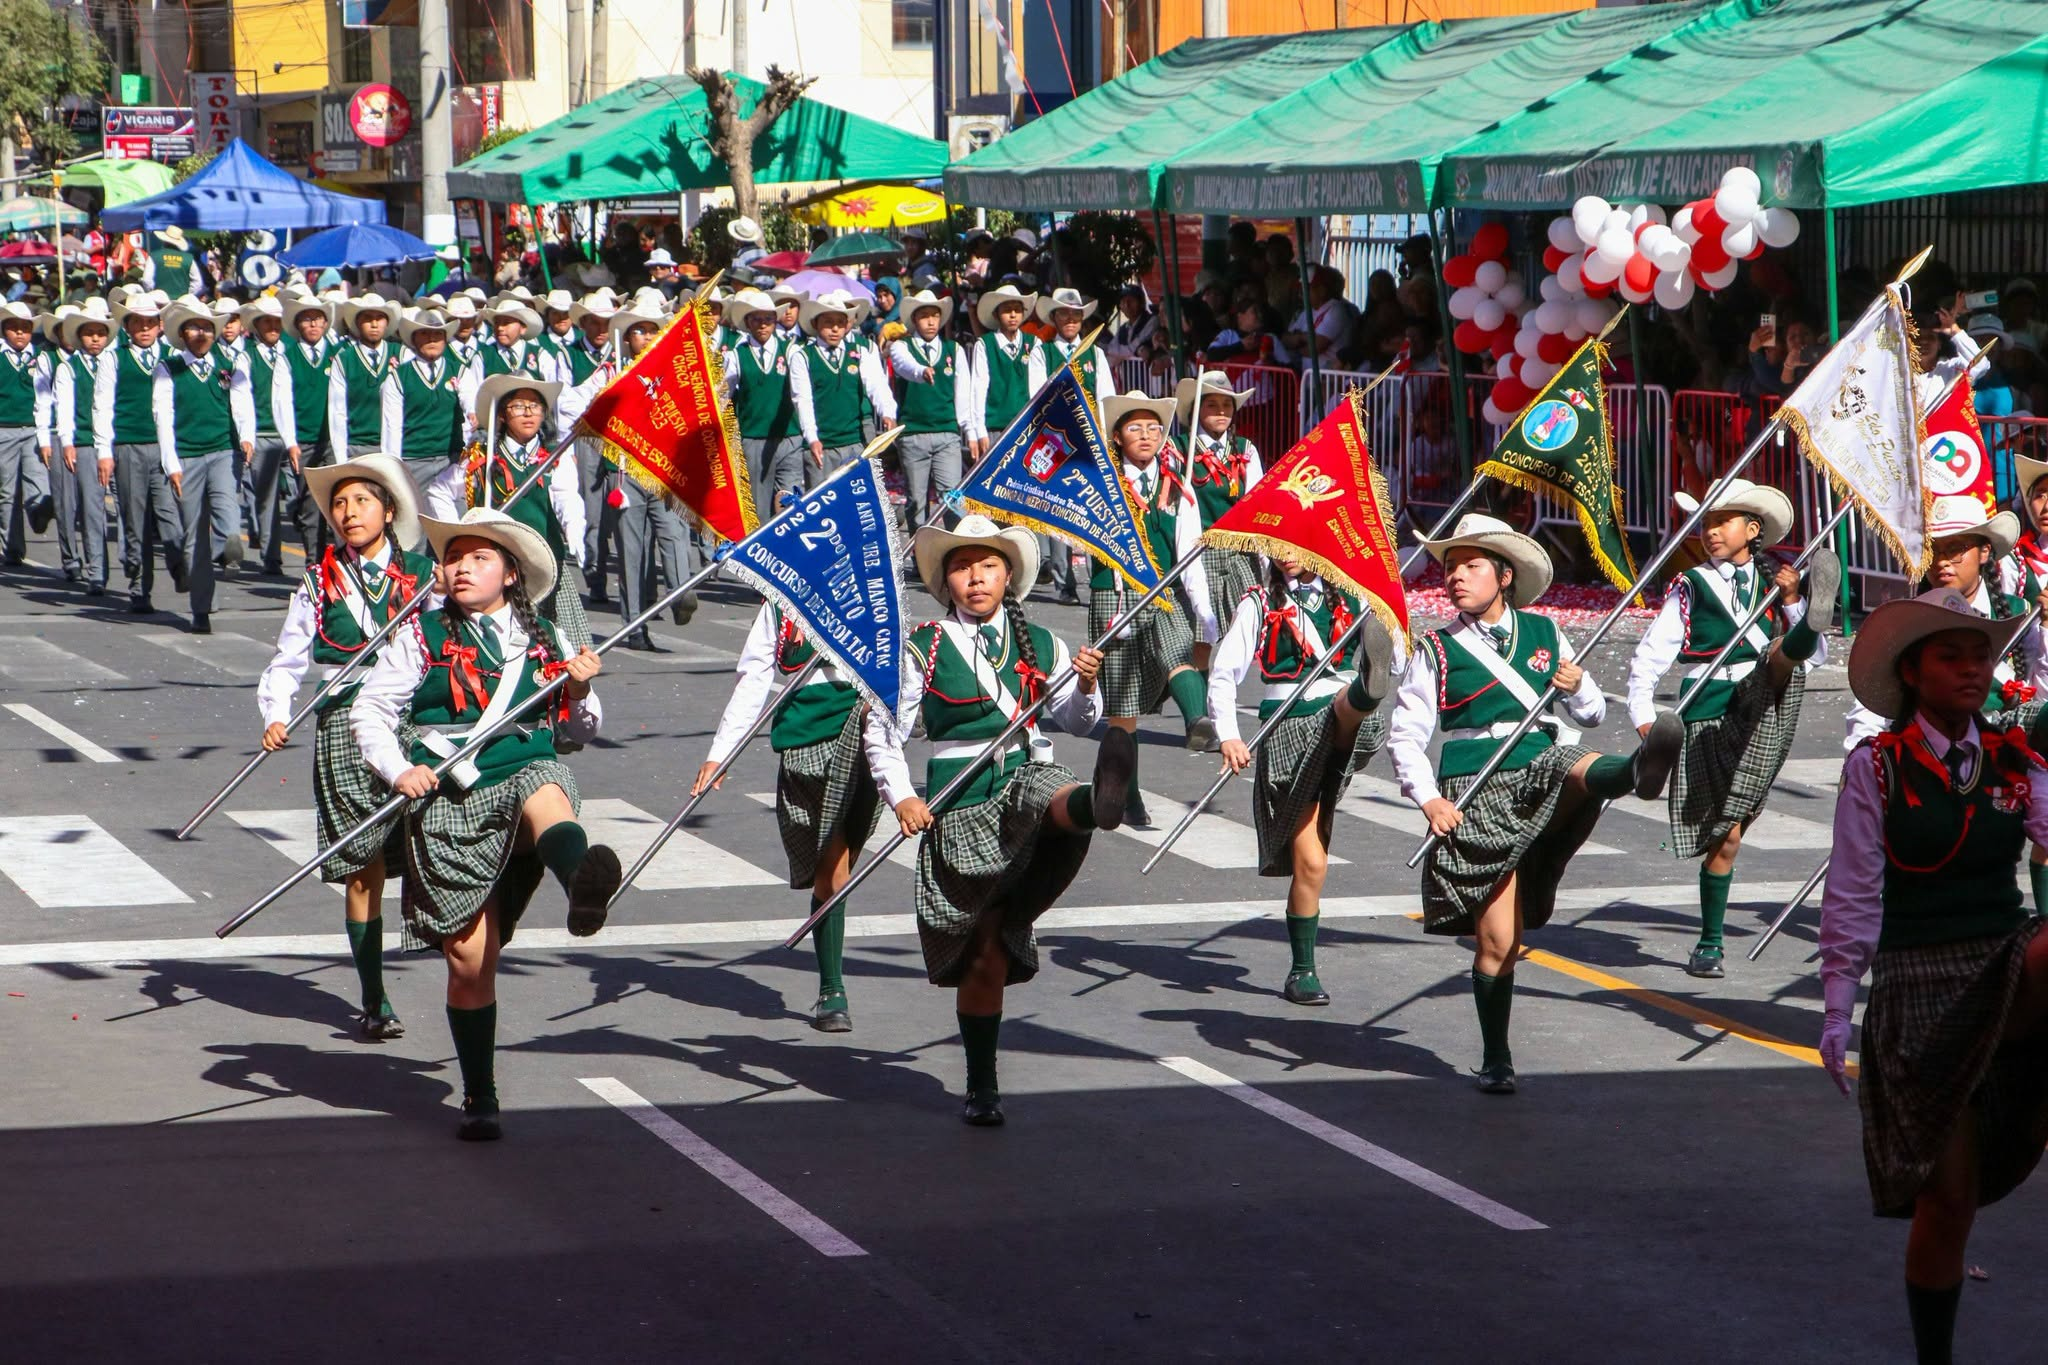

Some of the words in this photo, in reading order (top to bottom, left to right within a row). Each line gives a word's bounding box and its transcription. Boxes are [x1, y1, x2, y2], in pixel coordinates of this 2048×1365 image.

[1194, 175, 1257, 208] MUNICIPALIDAD
[1259, 174, 1304, 208] DISTRITAL
[1306, 173, 1318, 207] DE
[1320, 171, 1383, 206] PAUCARPATA
[1483, 164, 1567, 201] MUNICIPALIDAD
[1573, 158, 1638, 198] DISTRITAL
[1639, 157, 1660, 196] DE
[672, 354, 690, 389] CIRCA
[682, 341, 698, 369] NTRA.
[690, 371, 709, 411] SEÑORA
[662, 399, 689, 437] PUESTO
[698, 412, 712, 426] DE
[1072, 404, 1097, 443] VICTOR
[647, 447, 689, 488] ESCOLTAS
[702, 429, 728, 490] COPACABANA
[1092, 443, 1106, 474] RAUL
[1338, 422, 1367, 488] MUNICIPALIDAD
[1502, 450, 1557, 478] CONCURSO
[1559, 471, 1574, 487] DE
[849, 478, 867, 496] 59
[1103, 473, 1120, 502] HAYA
[1357, 489, 1369, 503] DE
[774, 490, 837, 537] 2025
[855, 501, 876, 538] ANIV.
[1077, 483, 1122, 539] PUESTO
[1114, 503, 1127, 518] DE
[1119, 519, 1132, 536] LA
[1252, 511, 1283, 527] 2025
[1361, 503, 1377, 526] ALTO
[800, 517, 847, 555] 2DO
[1051, 504, 1091, 531] CONCURSO
[1088, 523, 1101, 538] DE
[1100, 532, 1132, 565] ESCOLTAS
[1326, 517, 1356, 560] ESCOLTAS
[1336, 505, 1366, 549] CONCURSO
[1359, 544, 1375, 560] DE
[1368, 526, 1385, 550] SELVA
[861, 540, 880, 574] URB.
[1127, 537, 1148, 573] TORRE
[1379, 550, 1400, 584] ALEGRE
[746, 542, 812, 600] CONCURSO
[804, 591, 824, 616] DE
[817, 605, 874, 666] ESCOLTAS
[822, 553, 866, 620] PUESTO
[866, 577, 889, 624] MANCO
[875, 628, 891, 670] CAPAC
